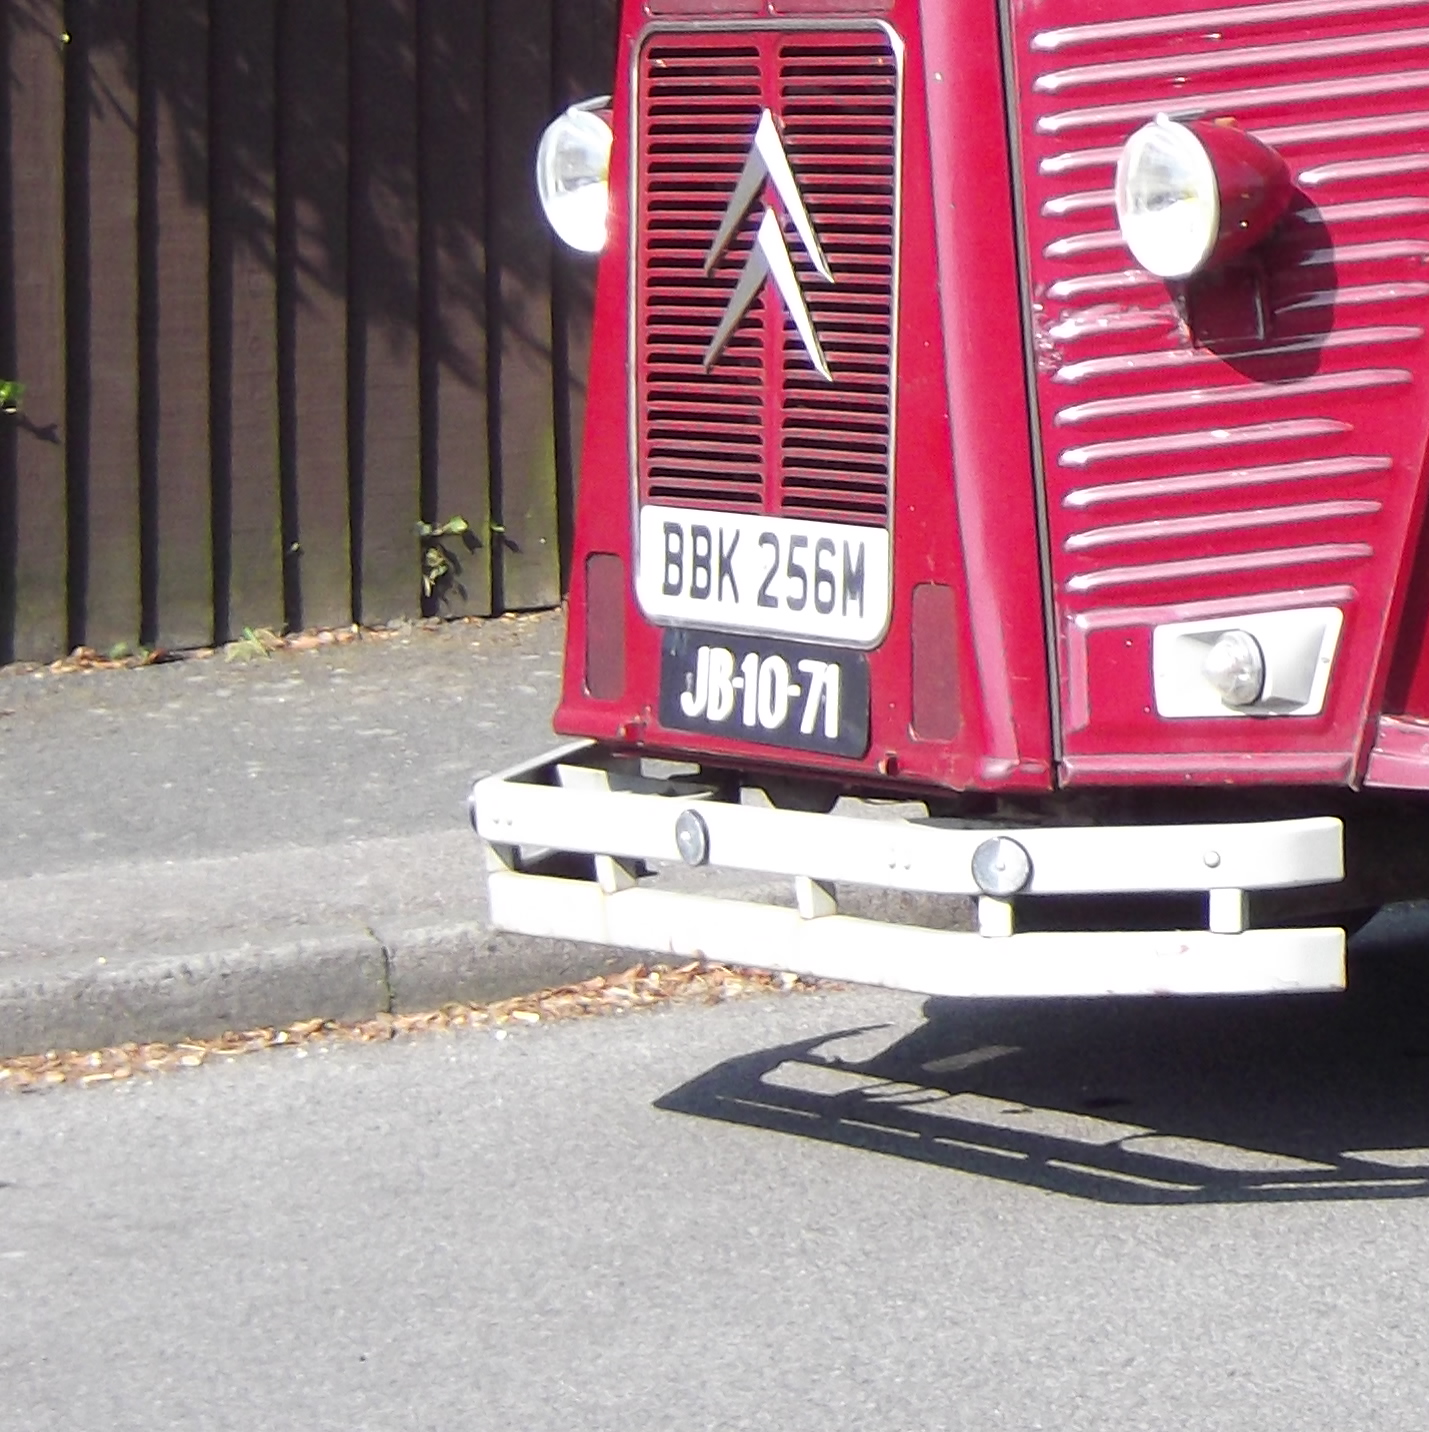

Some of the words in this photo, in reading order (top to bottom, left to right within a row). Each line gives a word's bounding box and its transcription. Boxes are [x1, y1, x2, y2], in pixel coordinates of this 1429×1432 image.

[661, 521, 741, 604] BBK
[756, 531, 866, 619] 256M
[680, 645, 841, 739] JB-10-71
